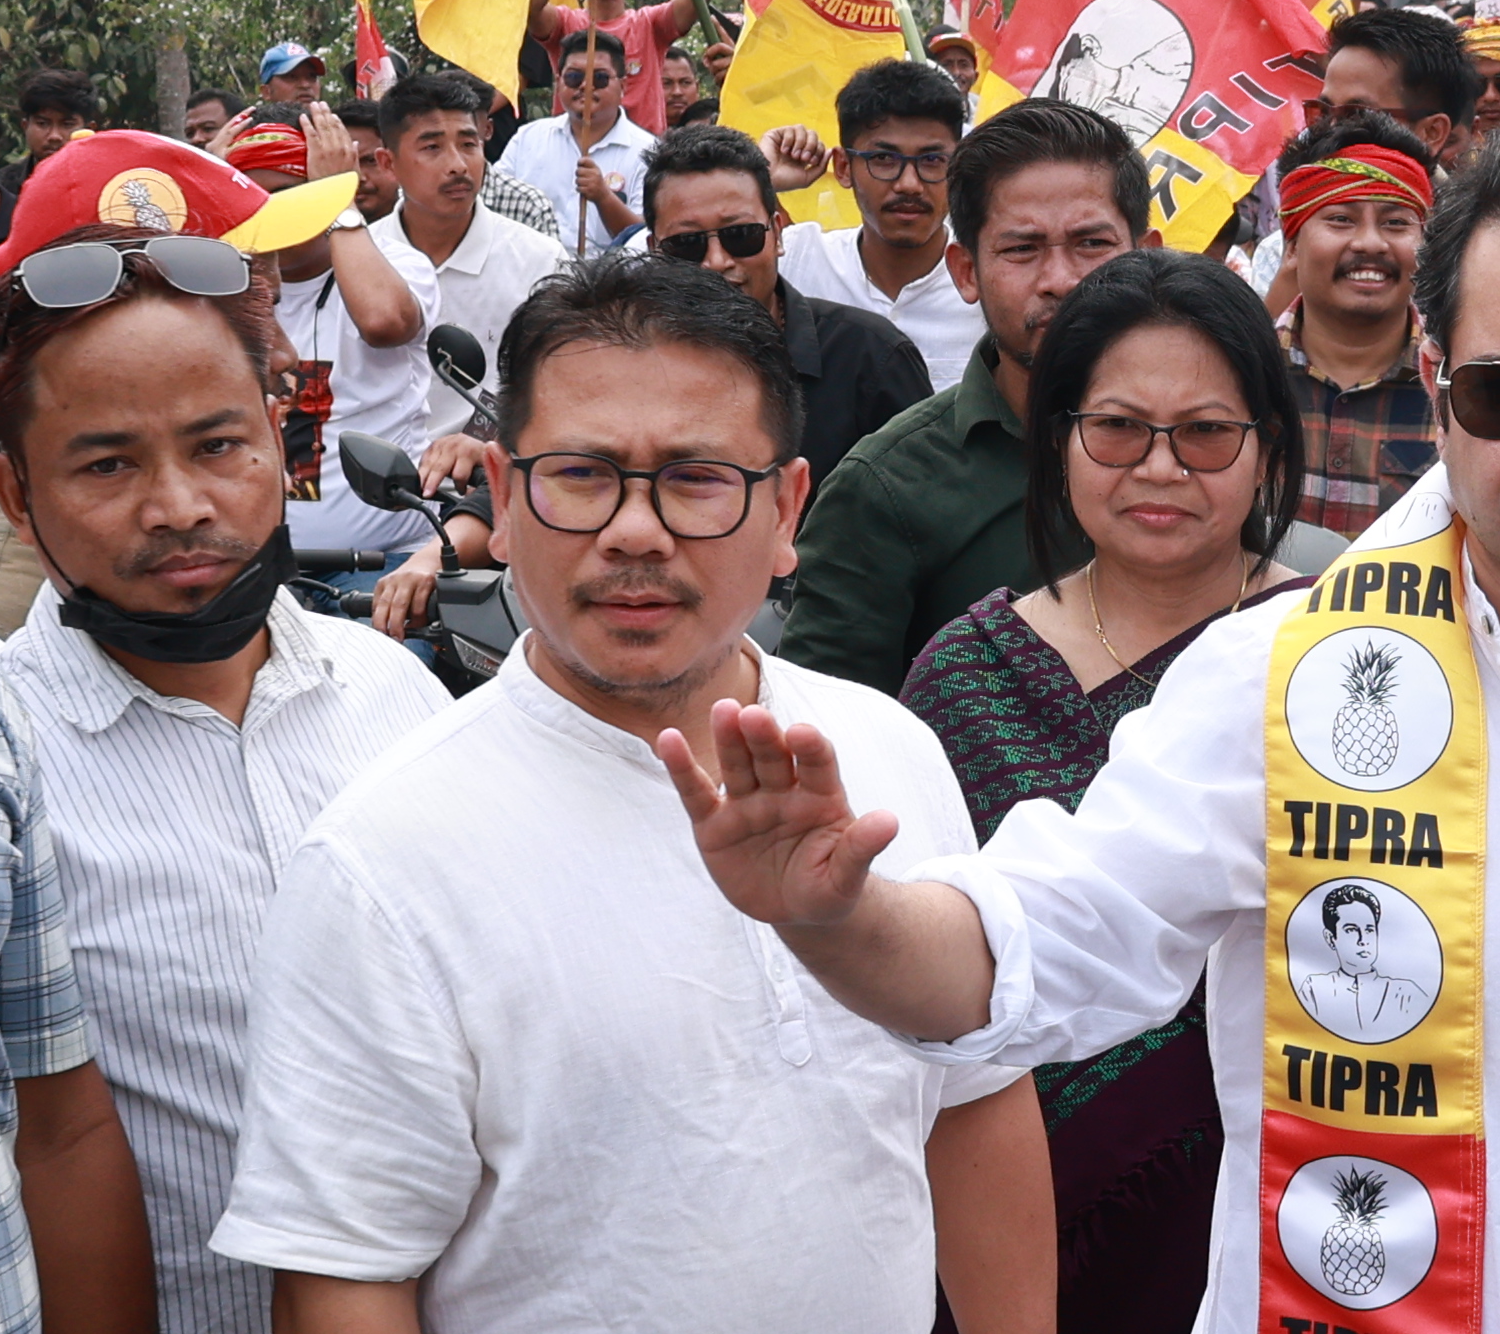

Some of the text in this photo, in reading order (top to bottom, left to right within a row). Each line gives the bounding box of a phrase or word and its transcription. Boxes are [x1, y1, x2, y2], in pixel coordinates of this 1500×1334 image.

[1306, 560, 1457, 623] TIPRA
[1283, 800, 1444, 869] TIPRA
[1281, 1043, 1438, 1118] TIPRA
